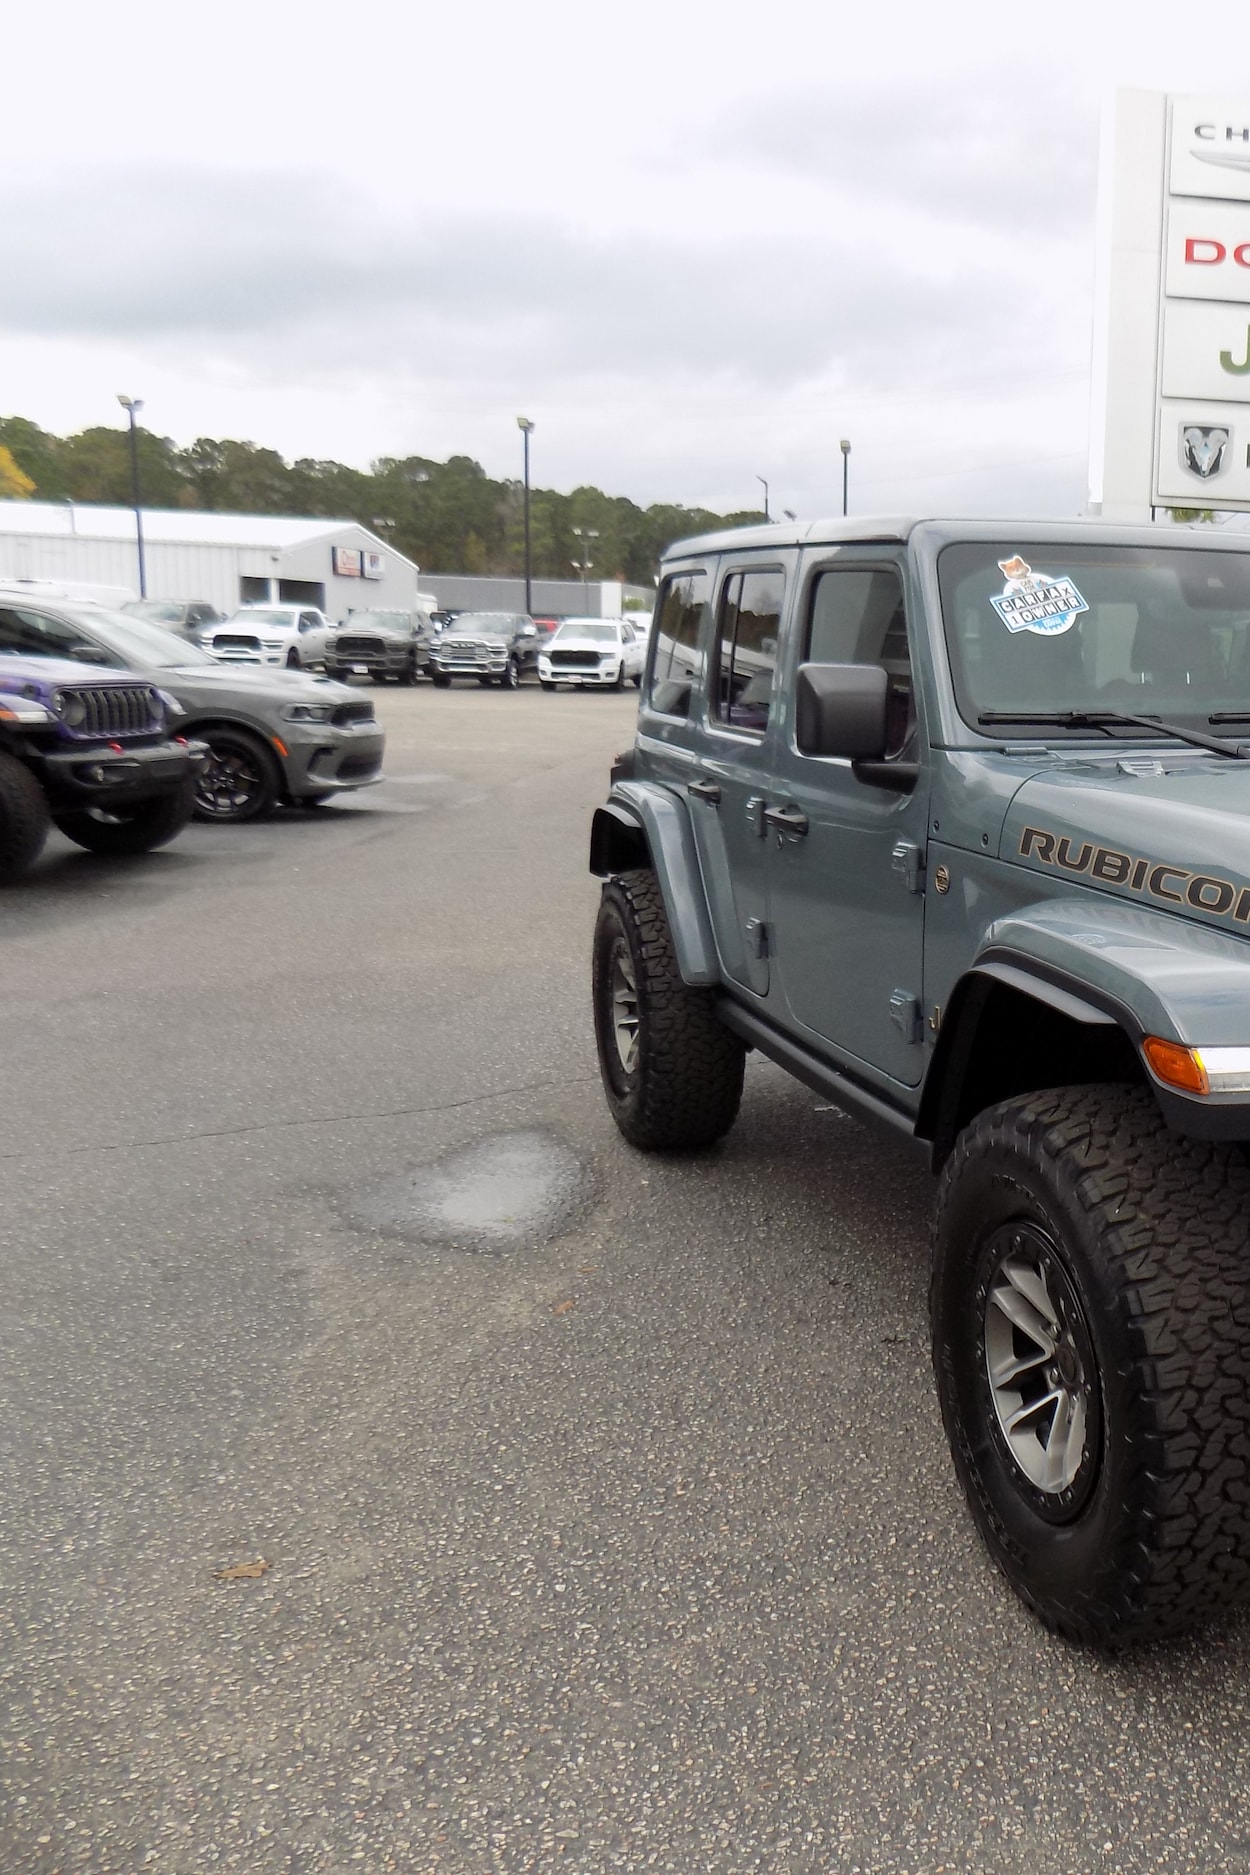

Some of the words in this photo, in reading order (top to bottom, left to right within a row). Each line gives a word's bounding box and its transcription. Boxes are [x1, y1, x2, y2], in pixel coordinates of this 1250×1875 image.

[1000, 587, 1072, 613] CARFAX
[1011, 615, 1021, 624] 1
[1021, 596, 1080, 623] OWNER
